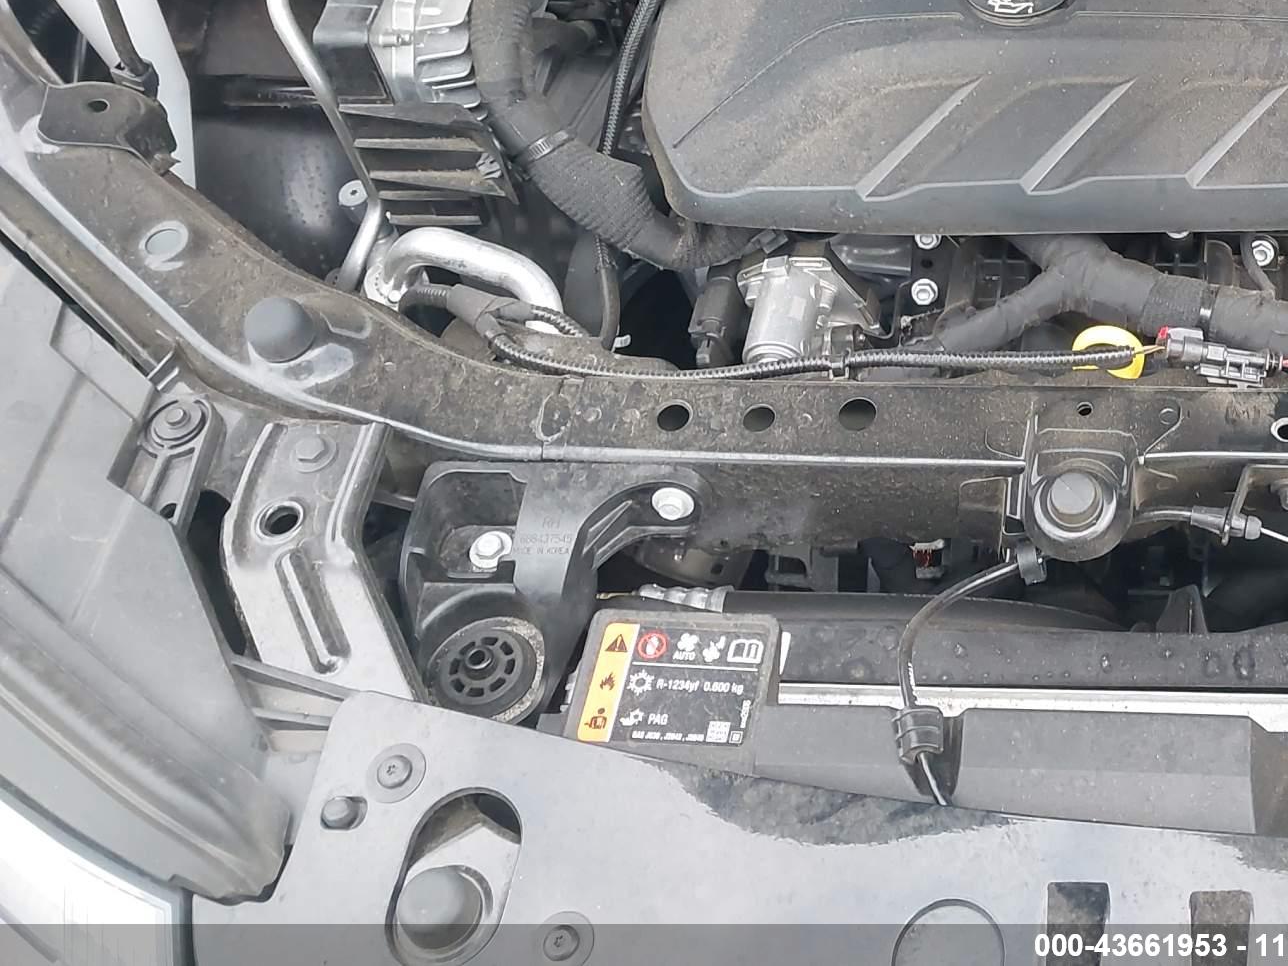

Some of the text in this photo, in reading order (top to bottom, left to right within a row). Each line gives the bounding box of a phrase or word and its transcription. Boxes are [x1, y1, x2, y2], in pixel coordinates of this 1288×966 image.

[672, 651, 696, 661] AUTO
[656, 679, 700, 694] R-1234yf
[731, 683, 744, 695] kg
[647, 713, 669, 726] PAG
